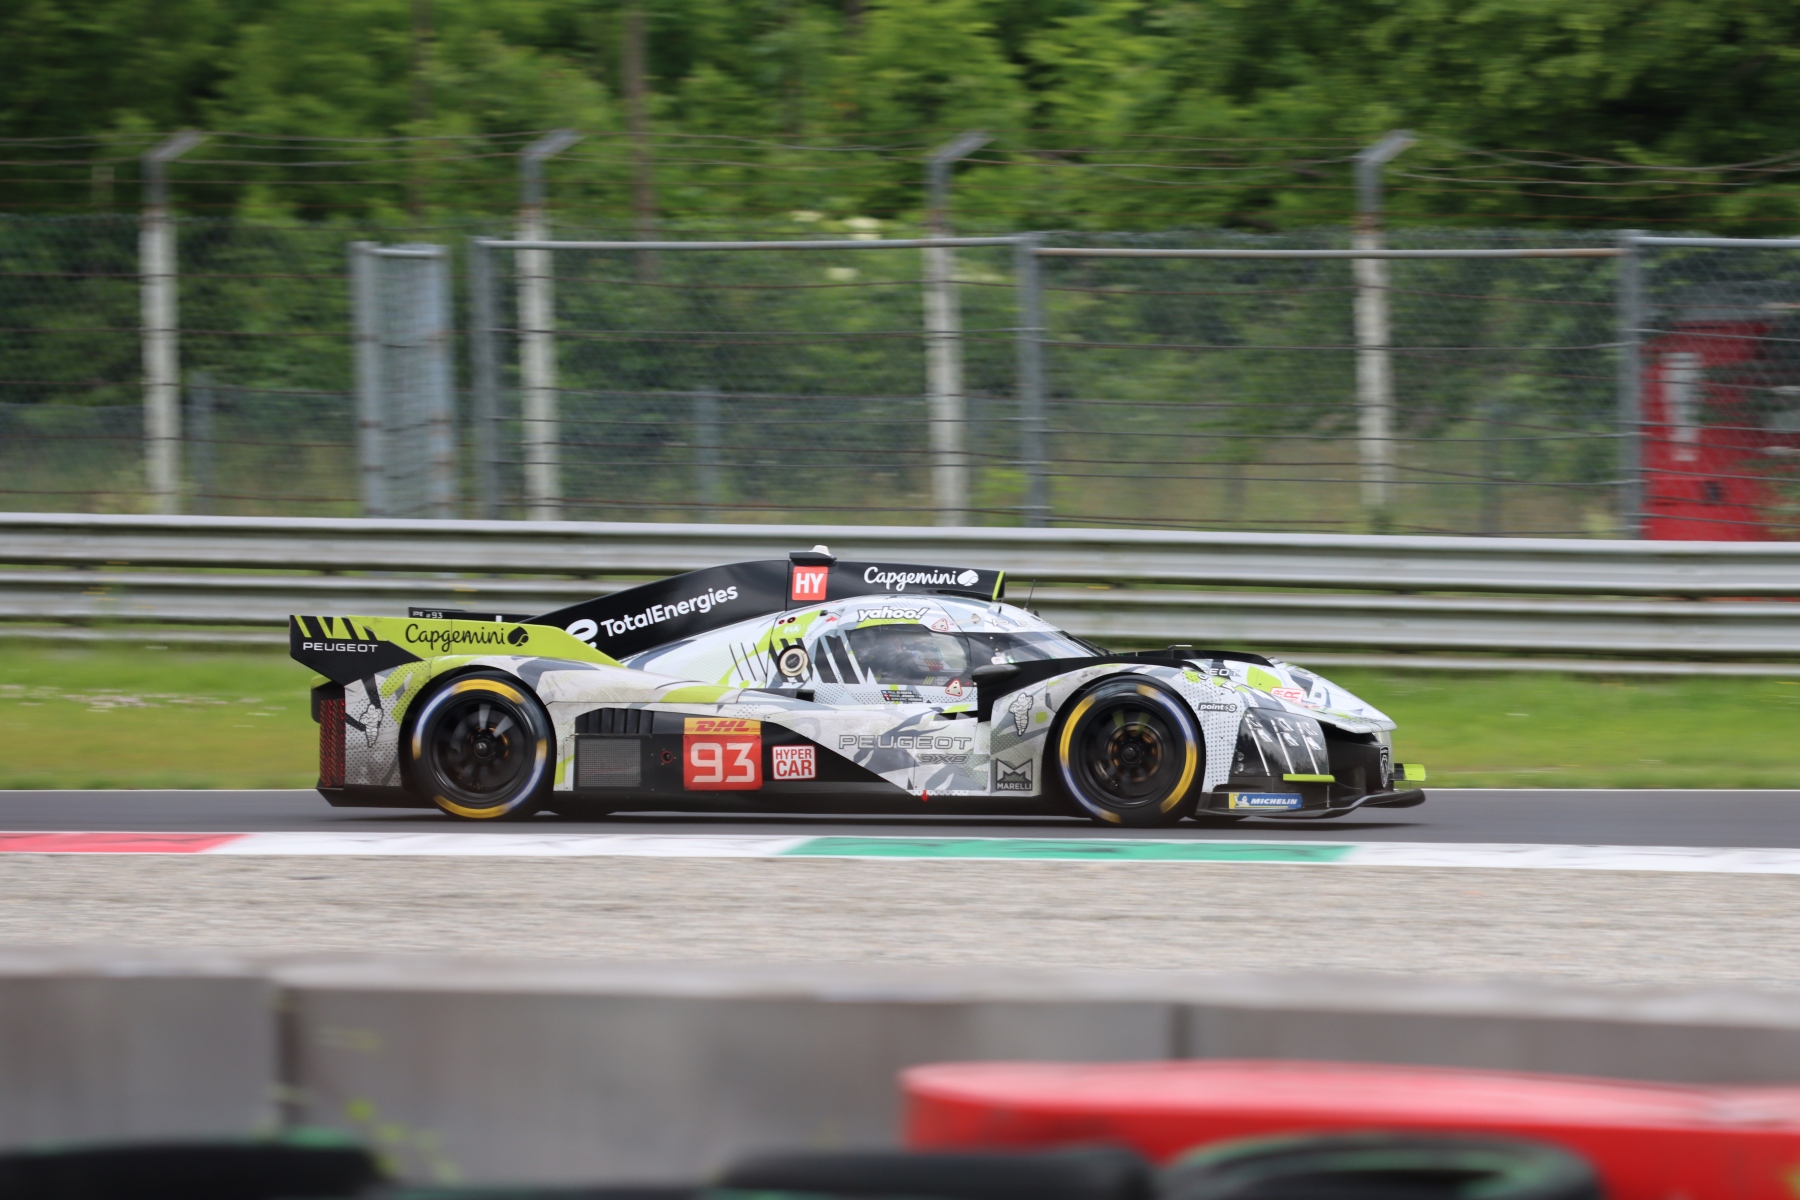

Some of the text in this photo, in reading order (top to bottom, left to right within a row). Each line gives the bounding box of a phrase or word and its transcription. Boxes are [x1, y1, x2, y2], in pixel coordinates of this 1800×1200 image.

[795, 573, 824, 594] HY
[863, 566, 957, 591] Capgemini
[600, 585, 738, 637] TotalEnergies
[857, 606, 931, 622] yahoo!
[405, 623, 506, 652] Capgemini
[302, 641, 378, 653] PEUGEOT
[693, 720, 751, 732] DHL
[838, 734, 972, 750] PEUGEOT
[775, 748, 812, 760] HYPER
[919, 754, 969, 764] 9X8
[690, 742, 755, 783] 93
[776, 760, 813, 777] CAR
[996, 782, 1033, 790] MARELLI
